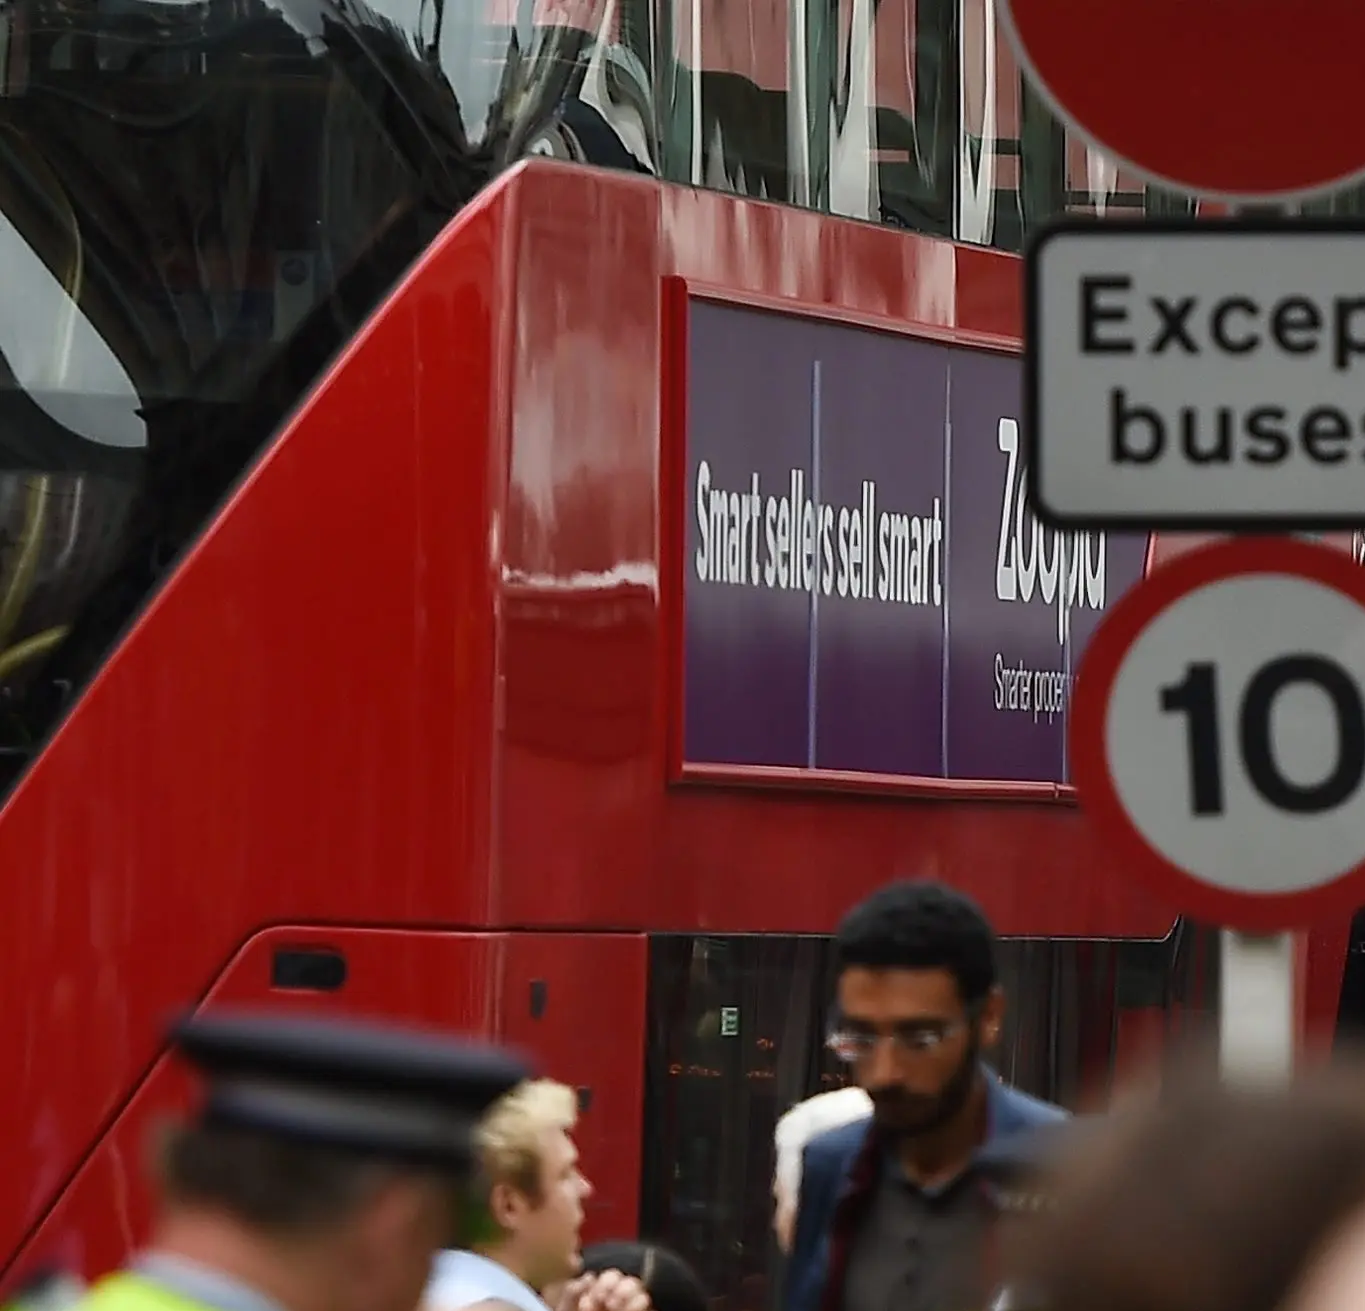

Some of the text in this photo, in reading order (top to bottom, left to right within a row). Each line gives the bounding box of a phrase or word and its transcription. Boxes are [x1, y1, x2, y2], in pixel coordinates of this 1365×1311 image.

[696, 460, 942, 607] Smart sellers sell smart
[994, 652, 1032, 711] Smarter
